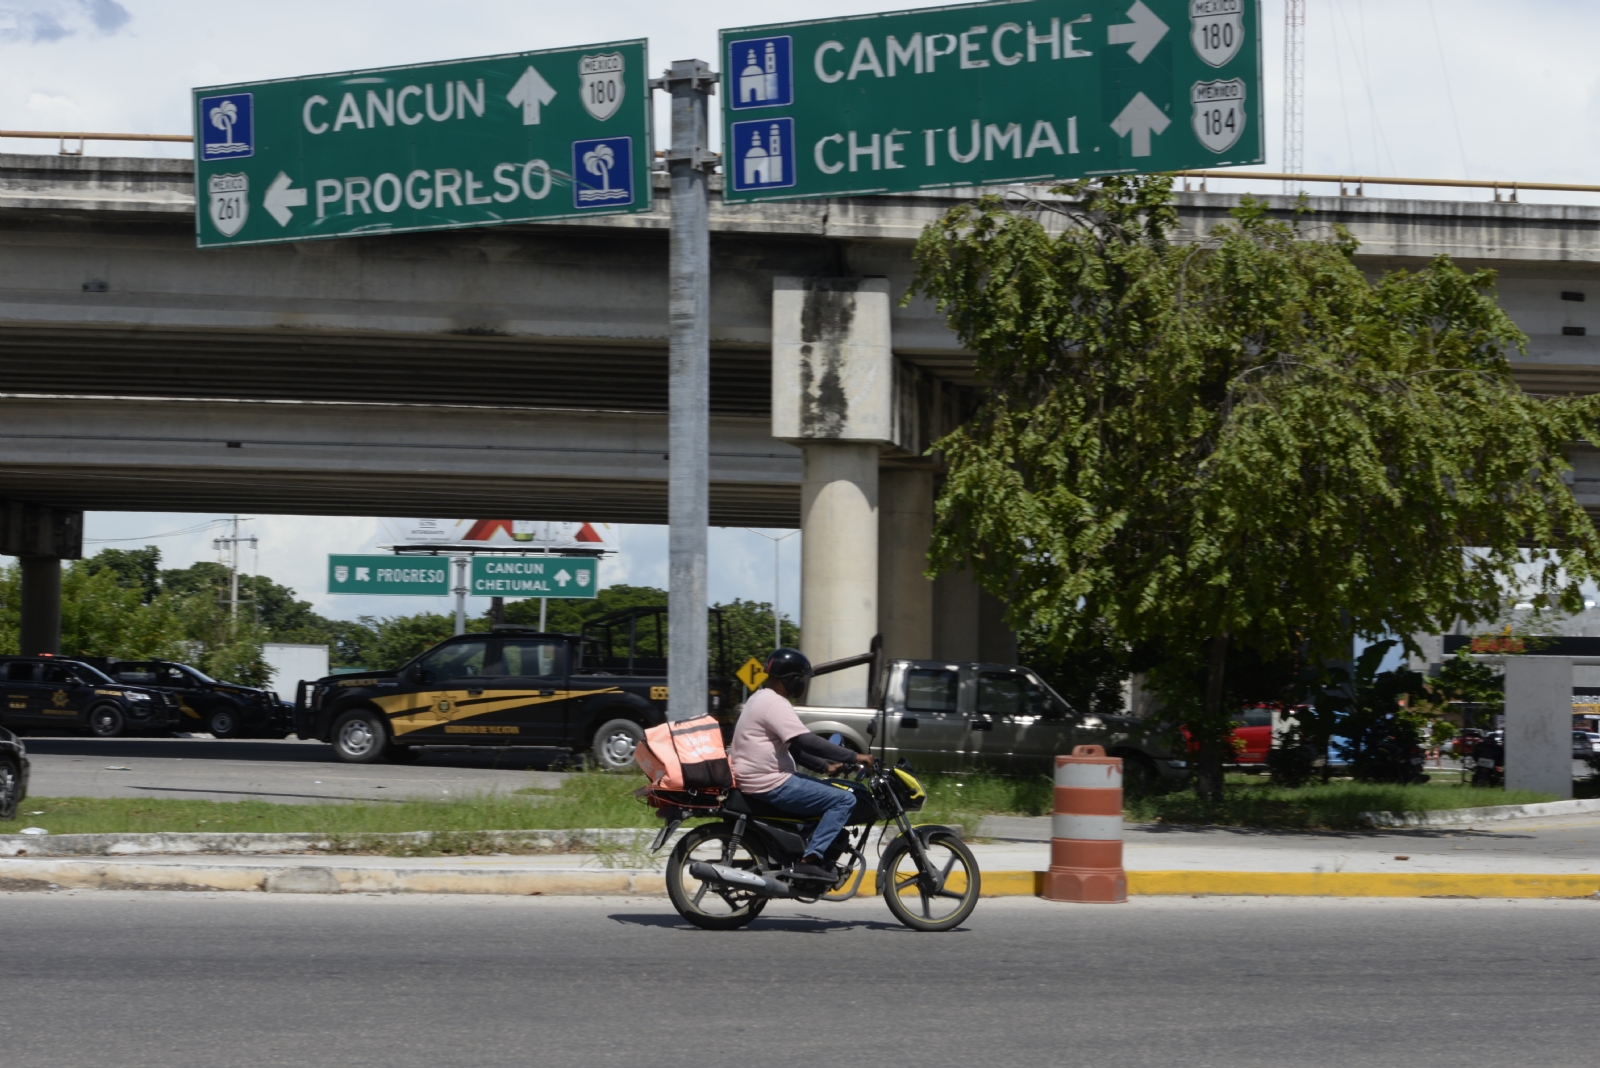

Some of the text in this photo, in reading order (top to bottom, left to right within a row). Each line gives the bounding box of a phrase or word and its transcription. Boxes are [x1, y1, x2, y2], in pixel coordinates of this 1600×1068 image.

[1201, 22, 1233, 49] 180
[813, 13, 1093, 84] CAMPECHE
[584, 58, 618, 71] MEXICO
[589, 79, 616, 104] 180
[1197, 85, 1238, 99] MEXICO
[302, 79, 485, 135] CANCUN
[1203, 107, 1235, 135] 184
[213, 178, 244, 191] MEXICO
[315, 159, 553, 218] PROGRESO
[217, 197, 241, 220] 261
[376, 568, 445, 583] PROGRESO
[485, 562, 544, 574] CANCUN
[475, 579, 551, 591] CHETUMAL
